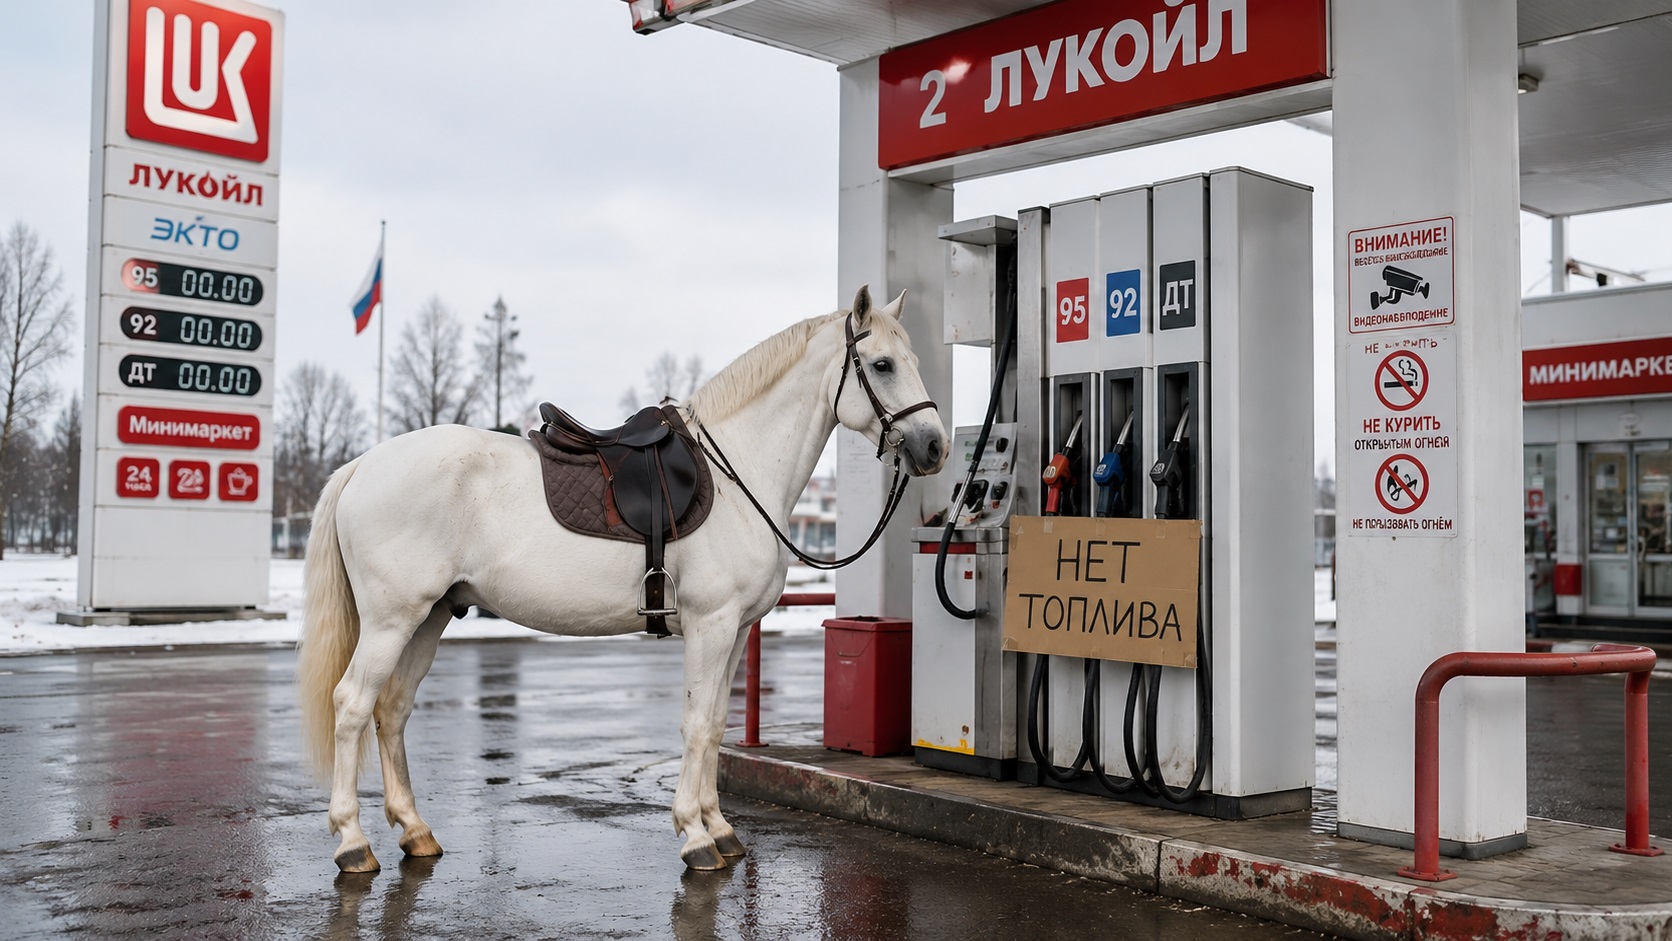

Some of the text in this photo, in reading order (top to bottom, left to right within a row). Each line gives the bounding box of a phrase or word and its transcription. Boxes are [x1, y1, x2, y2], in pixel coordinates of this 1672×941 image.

[919, 0, 1248, 129] 2 ЛУКОЙЛ
[129, 163, 263, 207] ЛУКОЙЛ
[151, 216, 240, 251] ЭКТО
[1354, 226, 1447, 253] ВНИМАНИЕ!
[131, 266, 254, 303] 95 00.00
[1162, 279, 1193, 316] ДТ
[1059, 295, 1086, 326] 95
[1109, 287, 1137, 319] 92
[130, 313, 252, 348] 92 00.00
[1364, 343, 1379, 354] НЕ
[128, 362, 251, 398] ДТ 00.00
[129, 415, 253, 443] Минимаркет
[1363, 416, 1441, 433] НЕ КУРИТЬ
[126, 465, 152, 483] 24
[1352, 518, 1363, 529] НЕ
[1056, 539, 1141, 584] НЕТ
[1019, 593, 1182, 642] ТОПЛИВА
